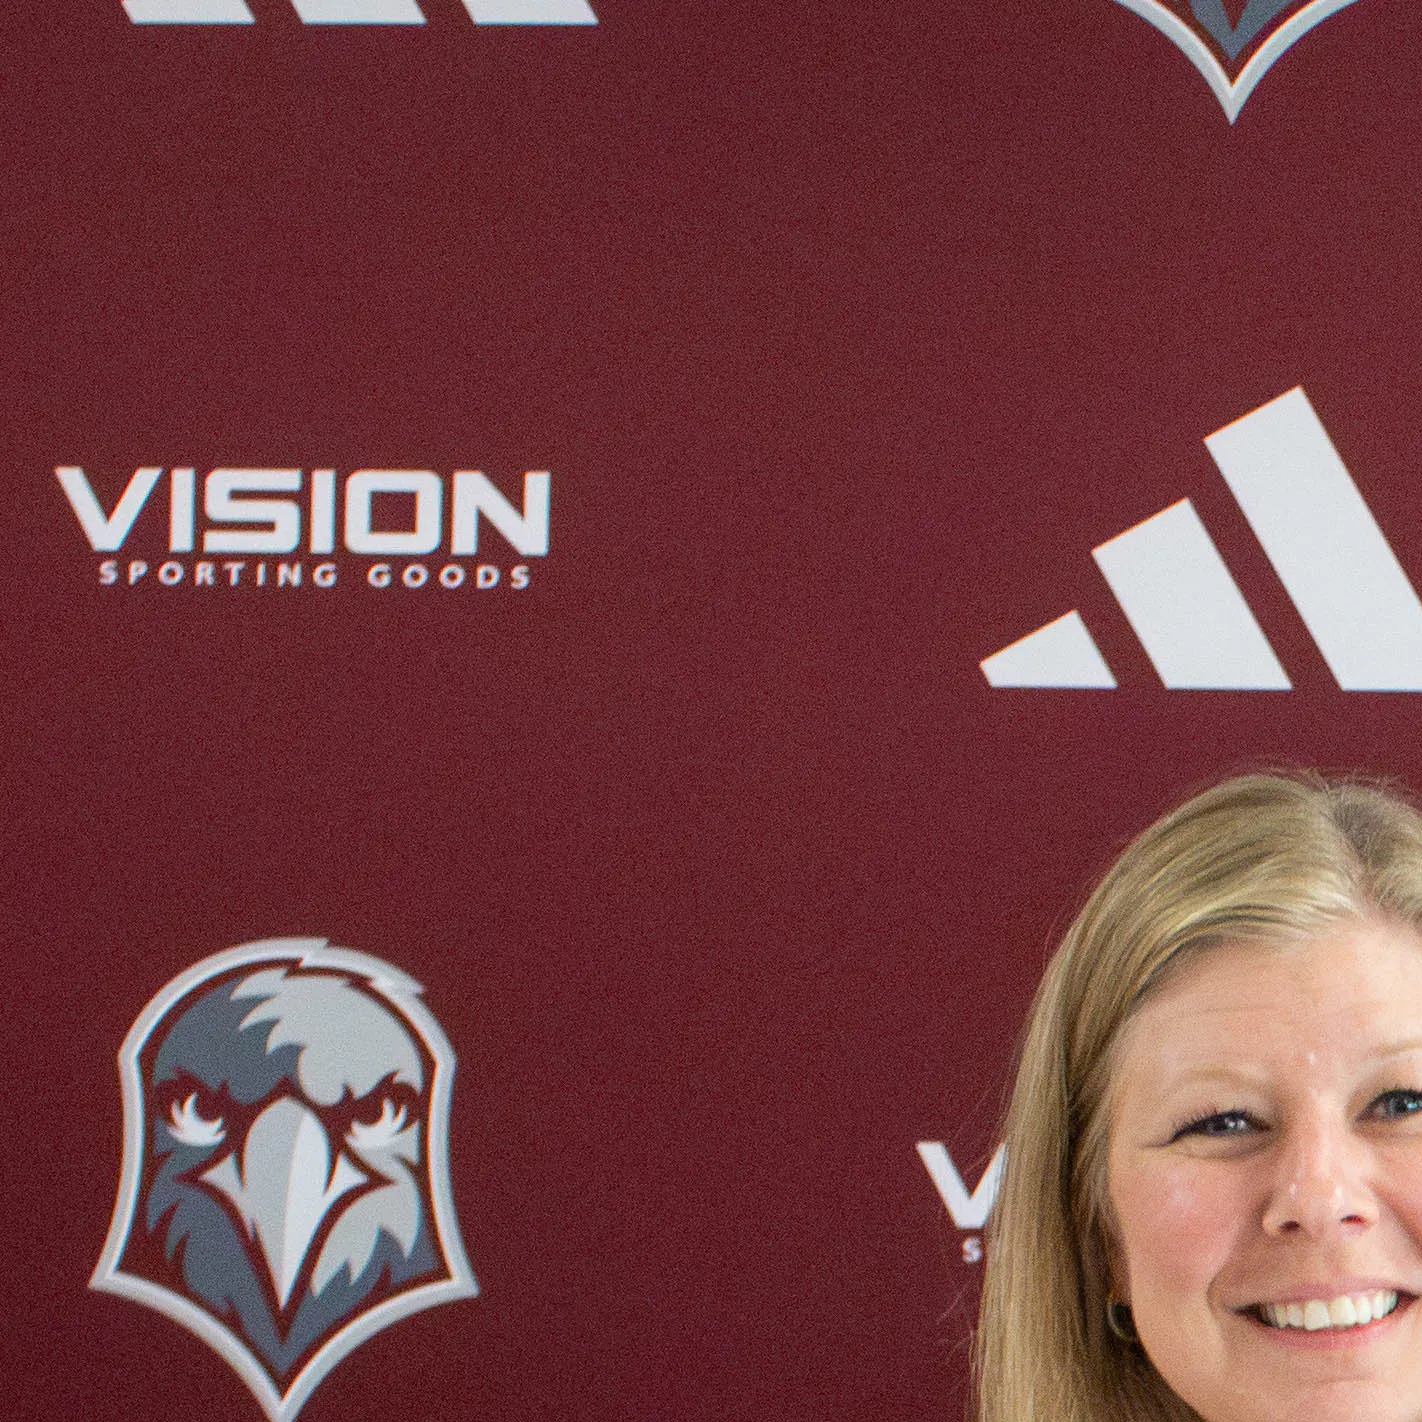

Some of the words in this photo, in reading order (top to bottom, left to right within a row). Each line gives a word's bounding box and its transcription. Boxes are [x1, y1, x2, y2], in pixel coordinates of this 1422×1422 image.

[54, 466, 552, 556] VISION
[99, 561, 337, 588] SPORTING
[366, 565, 532, 589] GOODS
